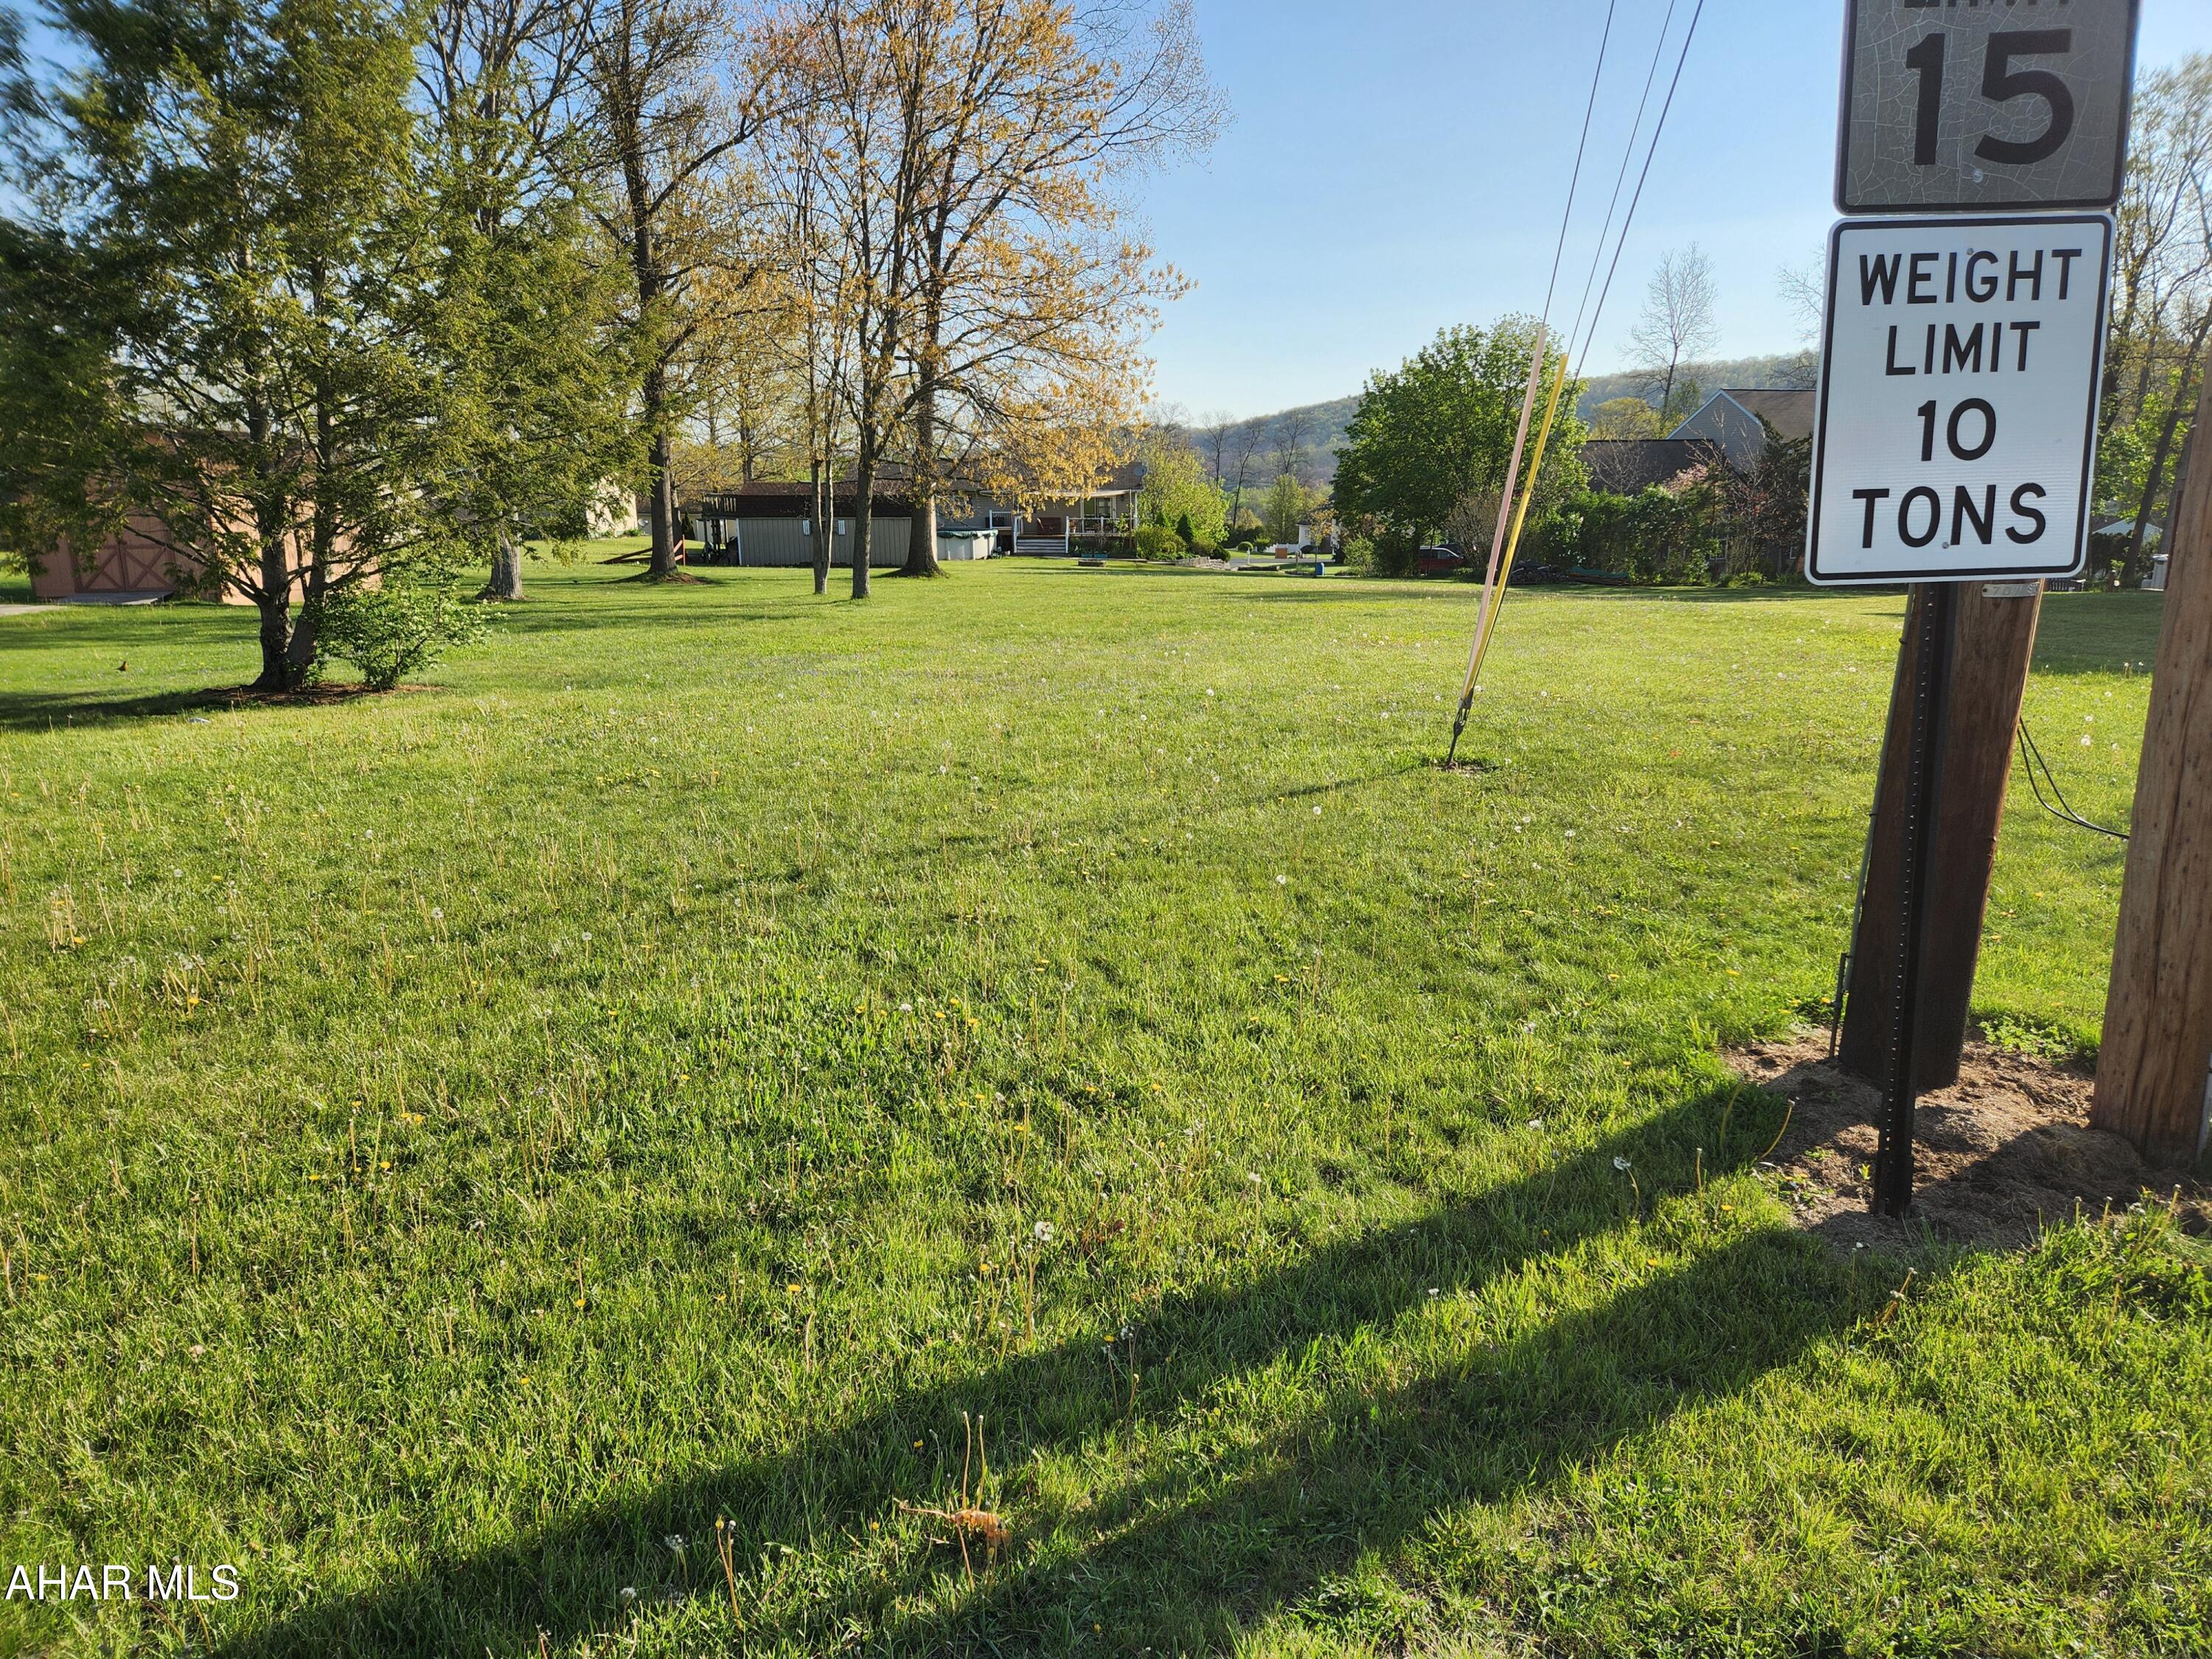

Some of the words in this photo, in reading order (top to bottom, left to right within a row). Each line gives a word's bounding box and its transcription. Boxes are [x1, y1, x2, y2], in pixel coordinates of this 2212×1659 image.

[1905, 28, 2074, 165] 15
[1859, 248, 2082, 306] WEIGHT
[1885, 320, 2040, 376] LIMIT
[1917, 397, 1997, 462] 10
[1852, 482, 2047, 549] TONS
